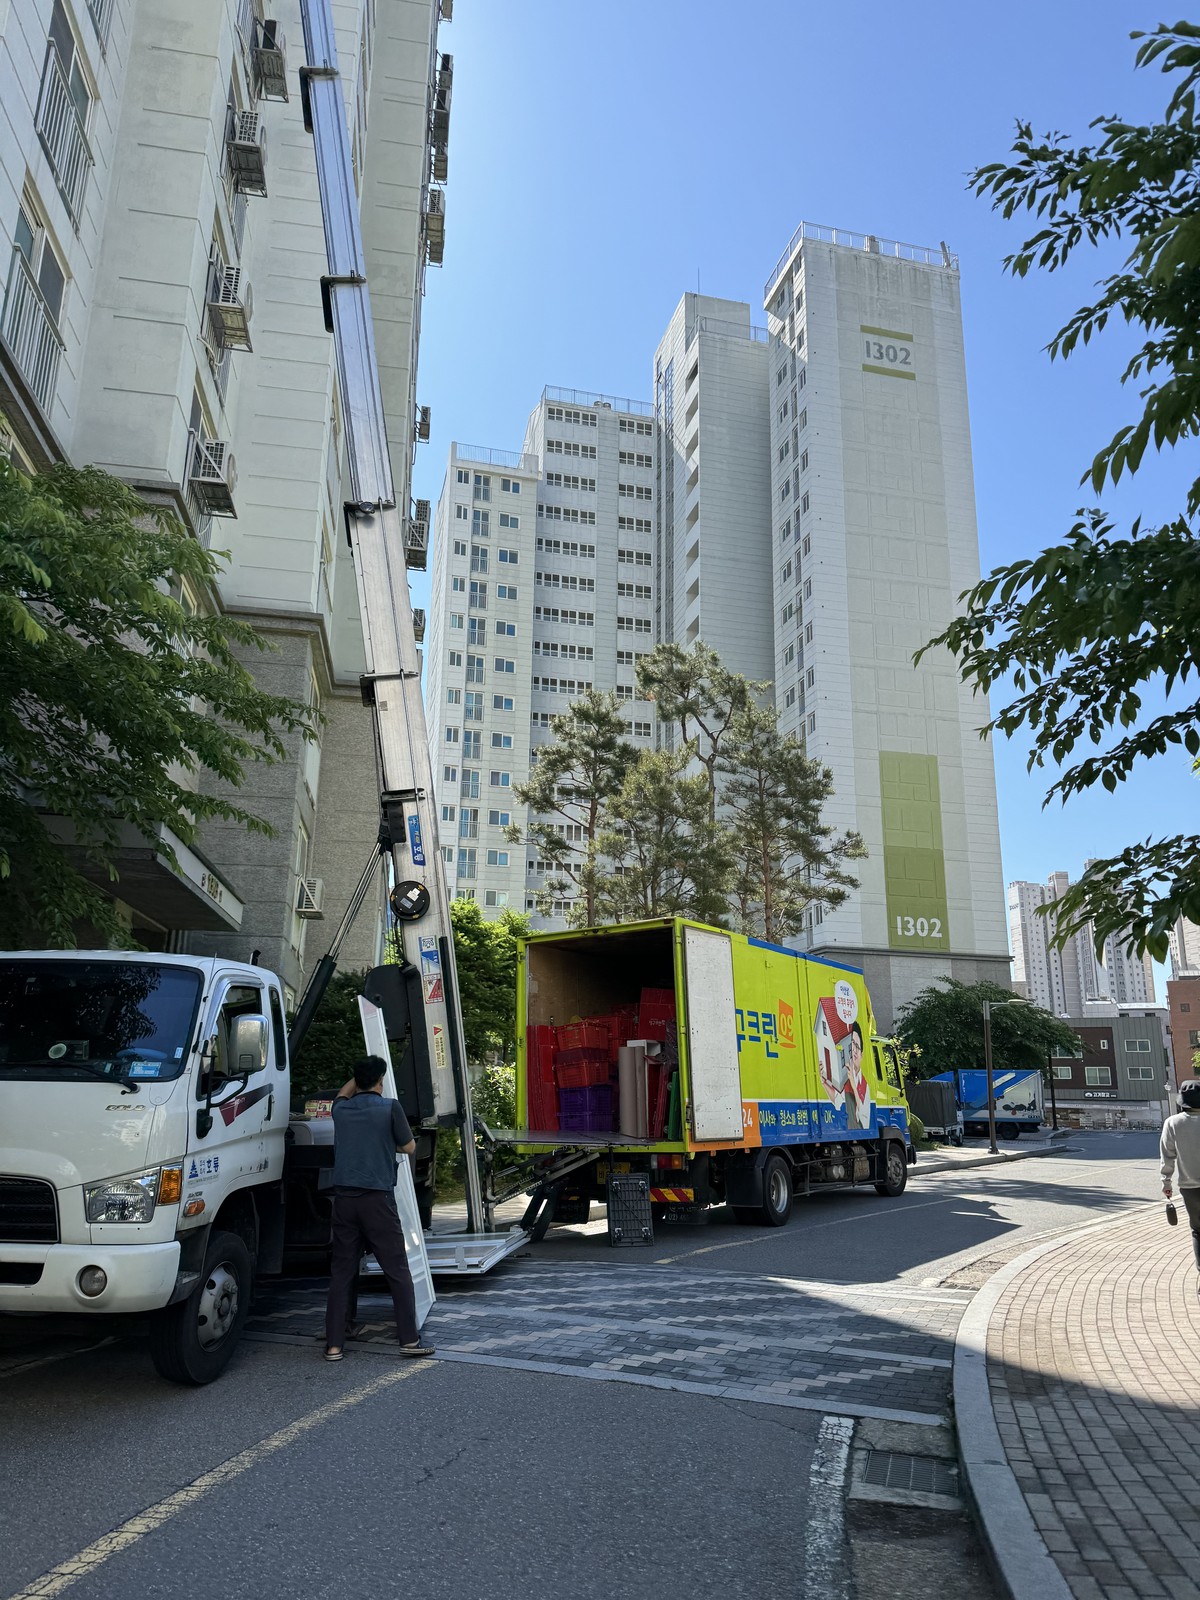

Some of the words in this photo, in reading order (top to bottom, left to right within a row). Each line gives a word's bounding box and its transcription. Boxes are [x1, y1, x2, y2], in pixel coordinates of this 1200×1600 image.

[865, 340, 911, 365] 1302
[896, 915, 942, 938] 1302
[759, 1109, 776, 1127] 이사와
[780, 1109, 796, 1127] 청소를
[206, 1156, 219, 1174] 호룡
